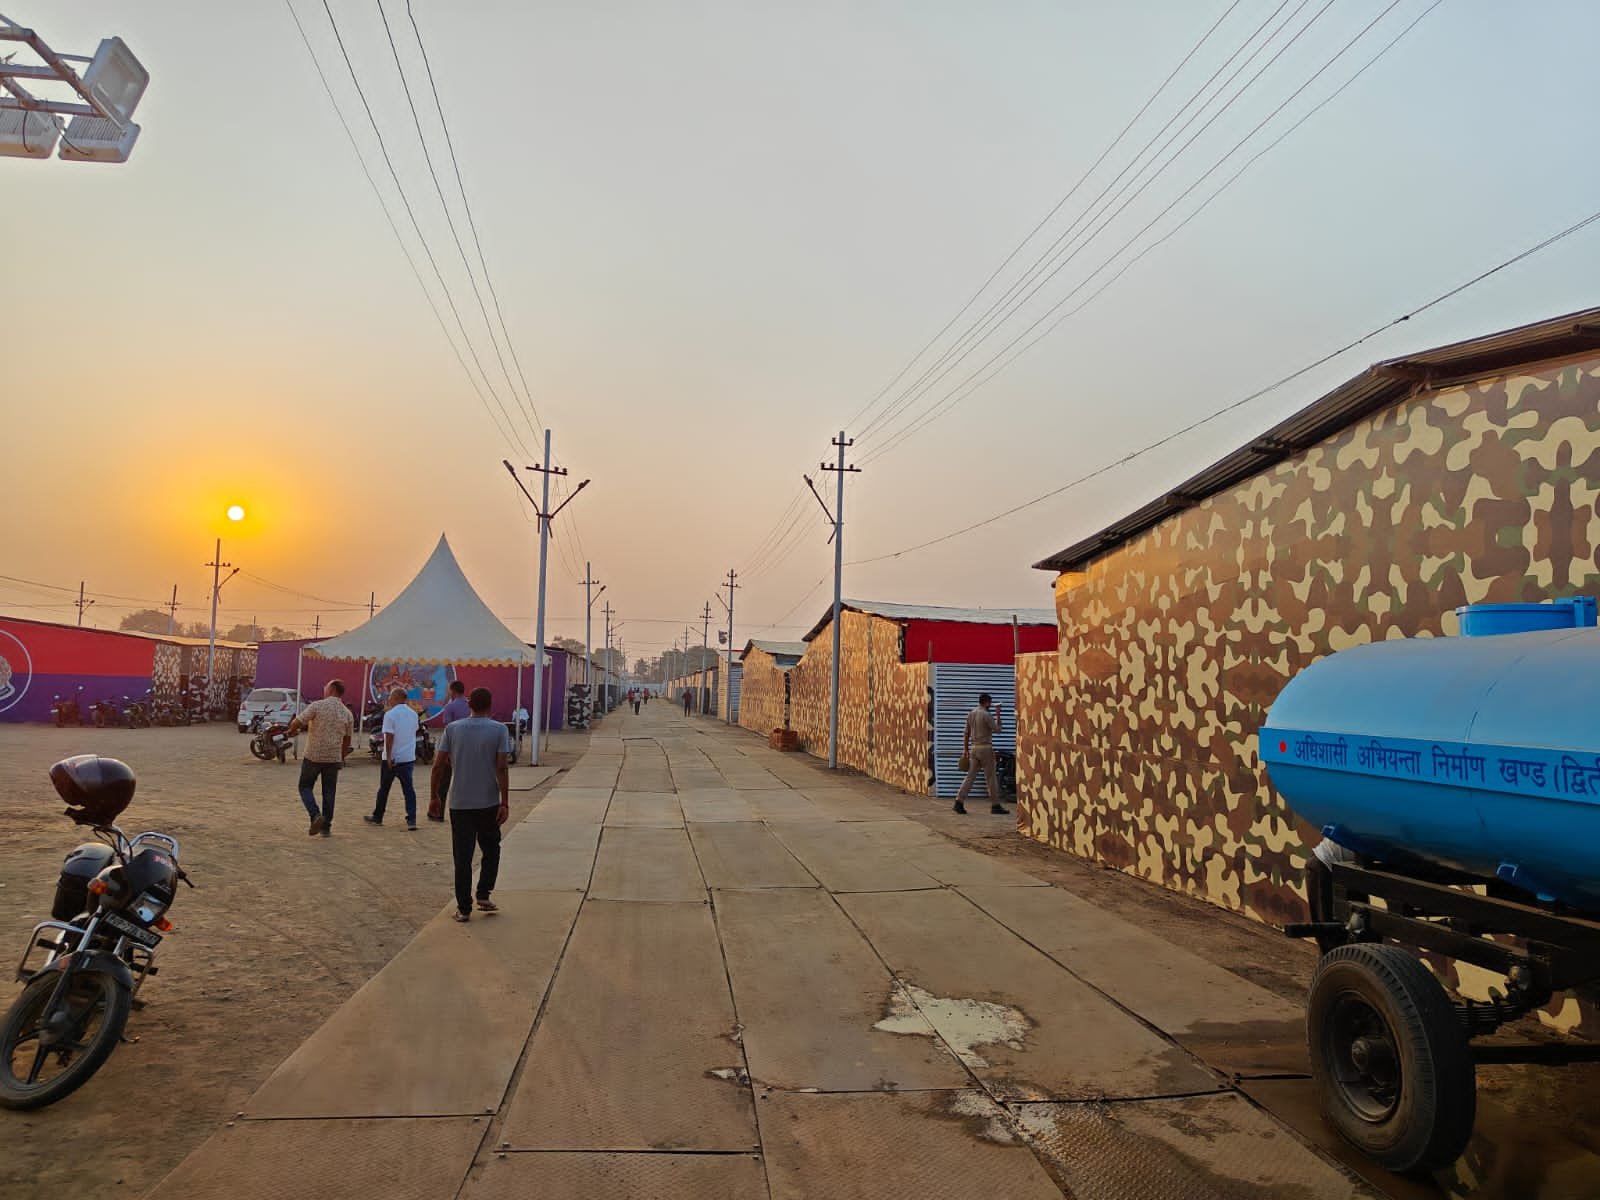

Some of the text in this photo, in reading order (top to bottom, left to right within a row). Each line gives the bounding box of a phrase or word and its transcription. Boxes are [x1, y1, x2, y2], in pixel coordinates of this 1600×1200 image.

[1357, 739, 1422, 775] अभियन्ता
[1432, 745, 1486, 783] निर्माण
[1498, 757, 1547, 788] खण्ड
